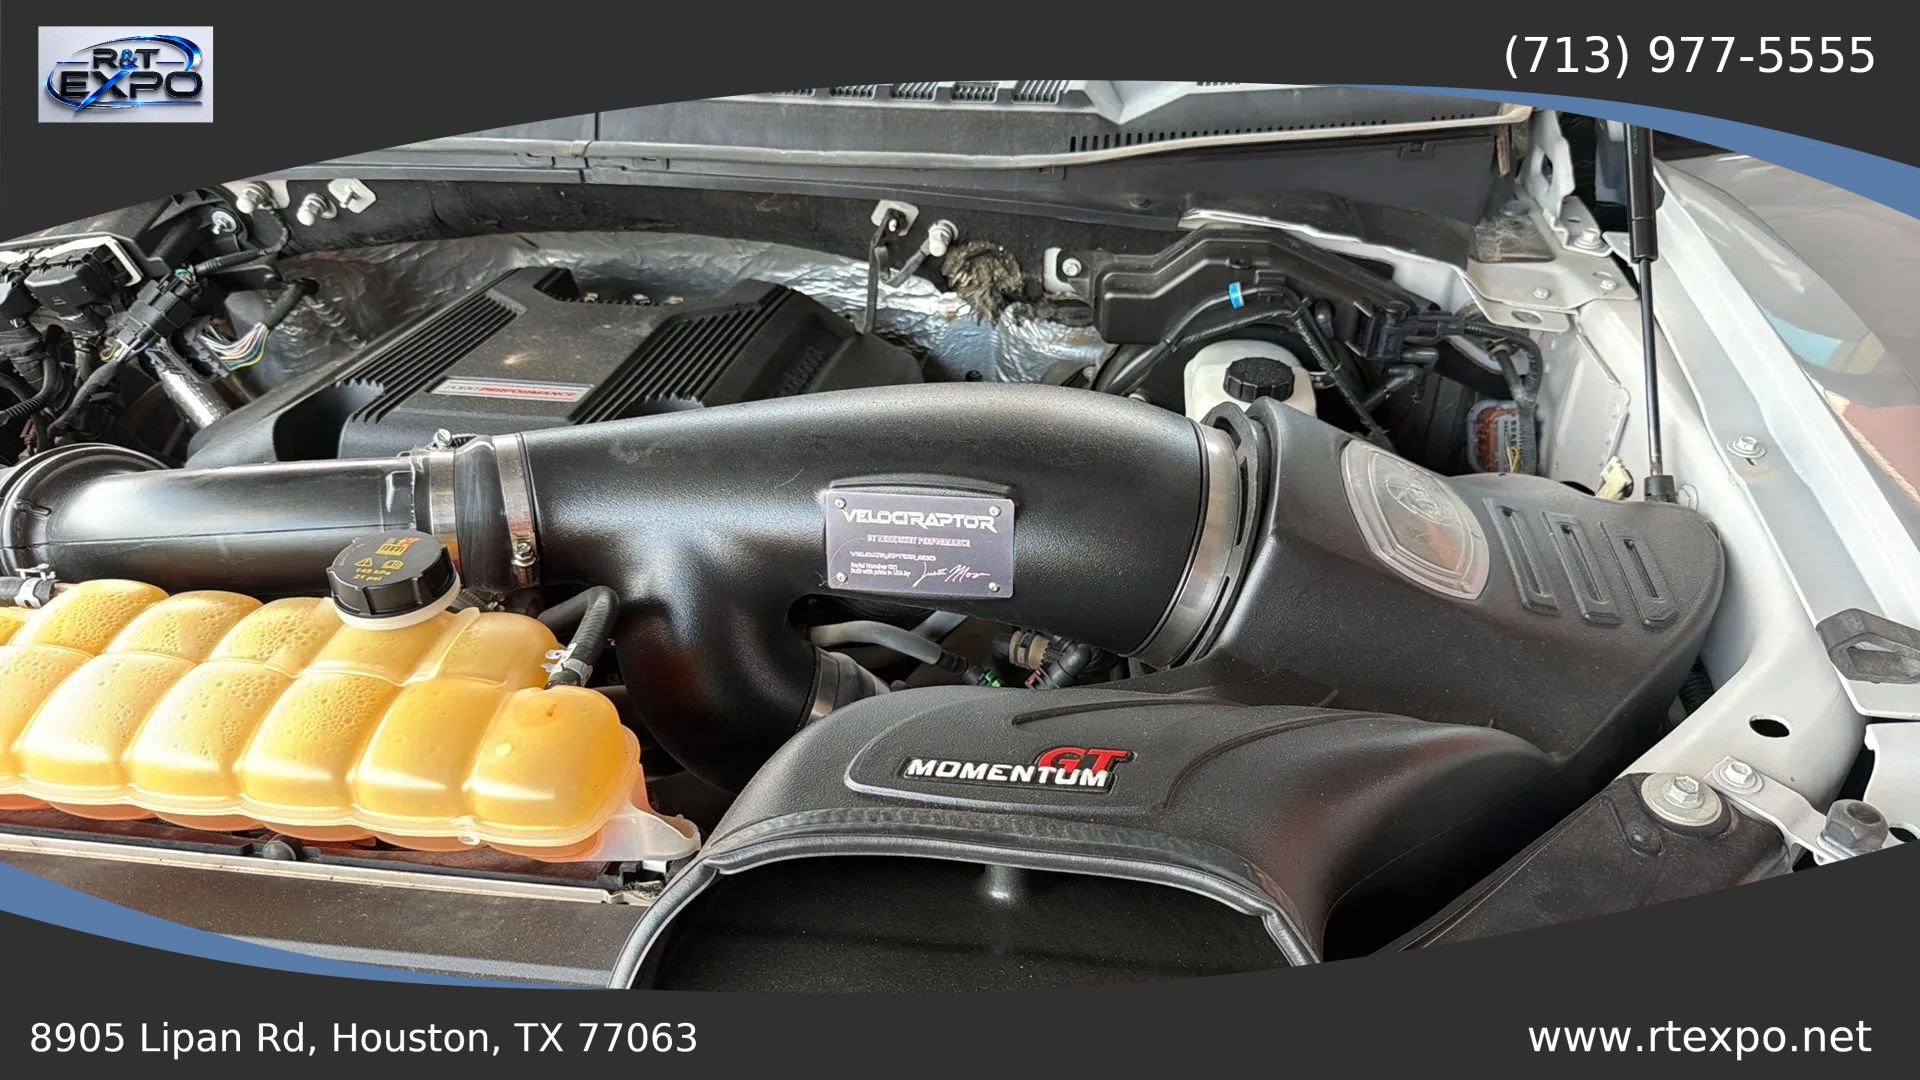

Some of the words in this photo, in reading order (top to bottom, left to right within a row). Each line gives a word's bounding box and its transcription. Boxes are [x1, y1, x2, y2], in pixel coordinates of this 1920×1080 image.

[479, 385, 577, 399] PERFORMANCE
[842, 508, 998, 534] VELOCIRAPTOR
[918, 536, 971, 548] PERFORMANCE
[907, 758, 1109, 788] MOMENTUM
[1037, 746, 1131, 776] GT
